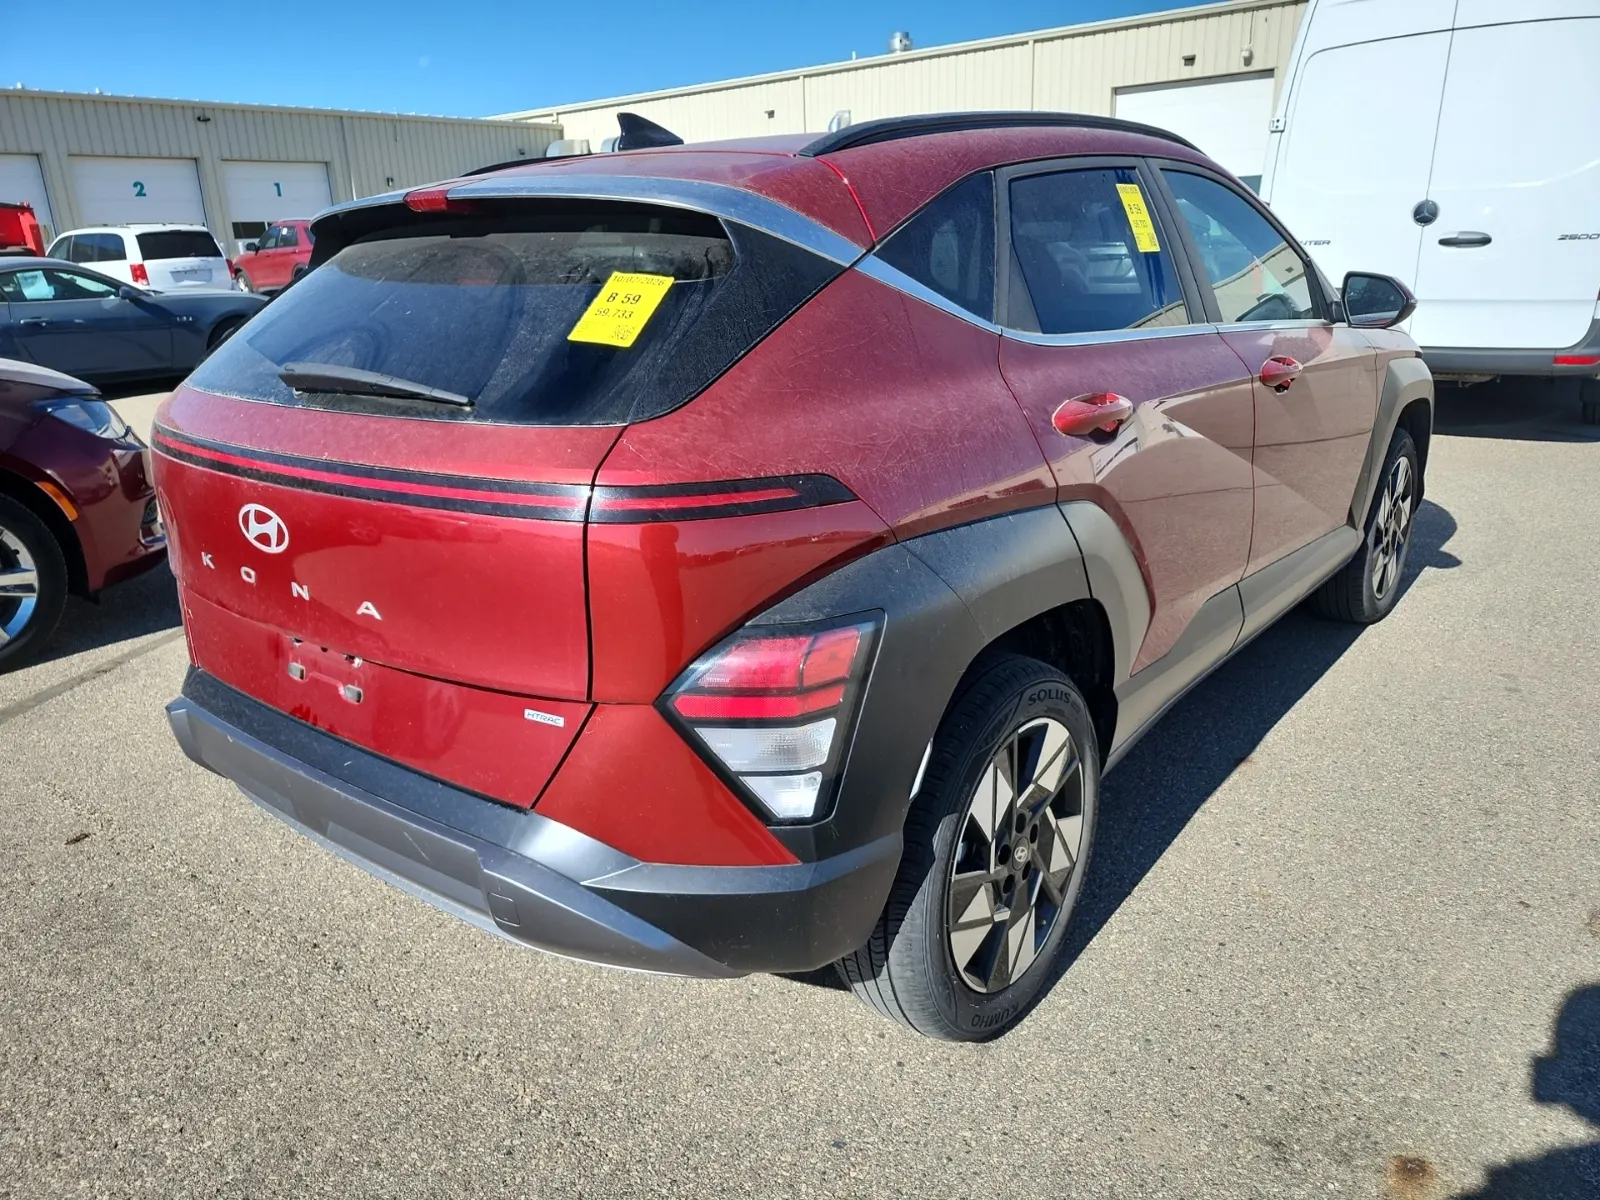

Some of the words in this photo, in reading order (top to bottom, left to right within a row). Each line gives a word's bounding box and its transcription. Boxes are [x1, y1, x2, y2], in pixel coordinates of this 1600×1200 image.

[132, 180, 147, 198] 2
[273, 182, 282, 198] 1
[606, 292, 619, 303] B
[621, 293, 642, 305] 59
[594, 307, 634, 319] 59.733
[1027, 688, 1072, 706] SOLUS
[526, 711, 561, 725] HTRAC
[970, 1001, 1020, 1028] KUMHO
